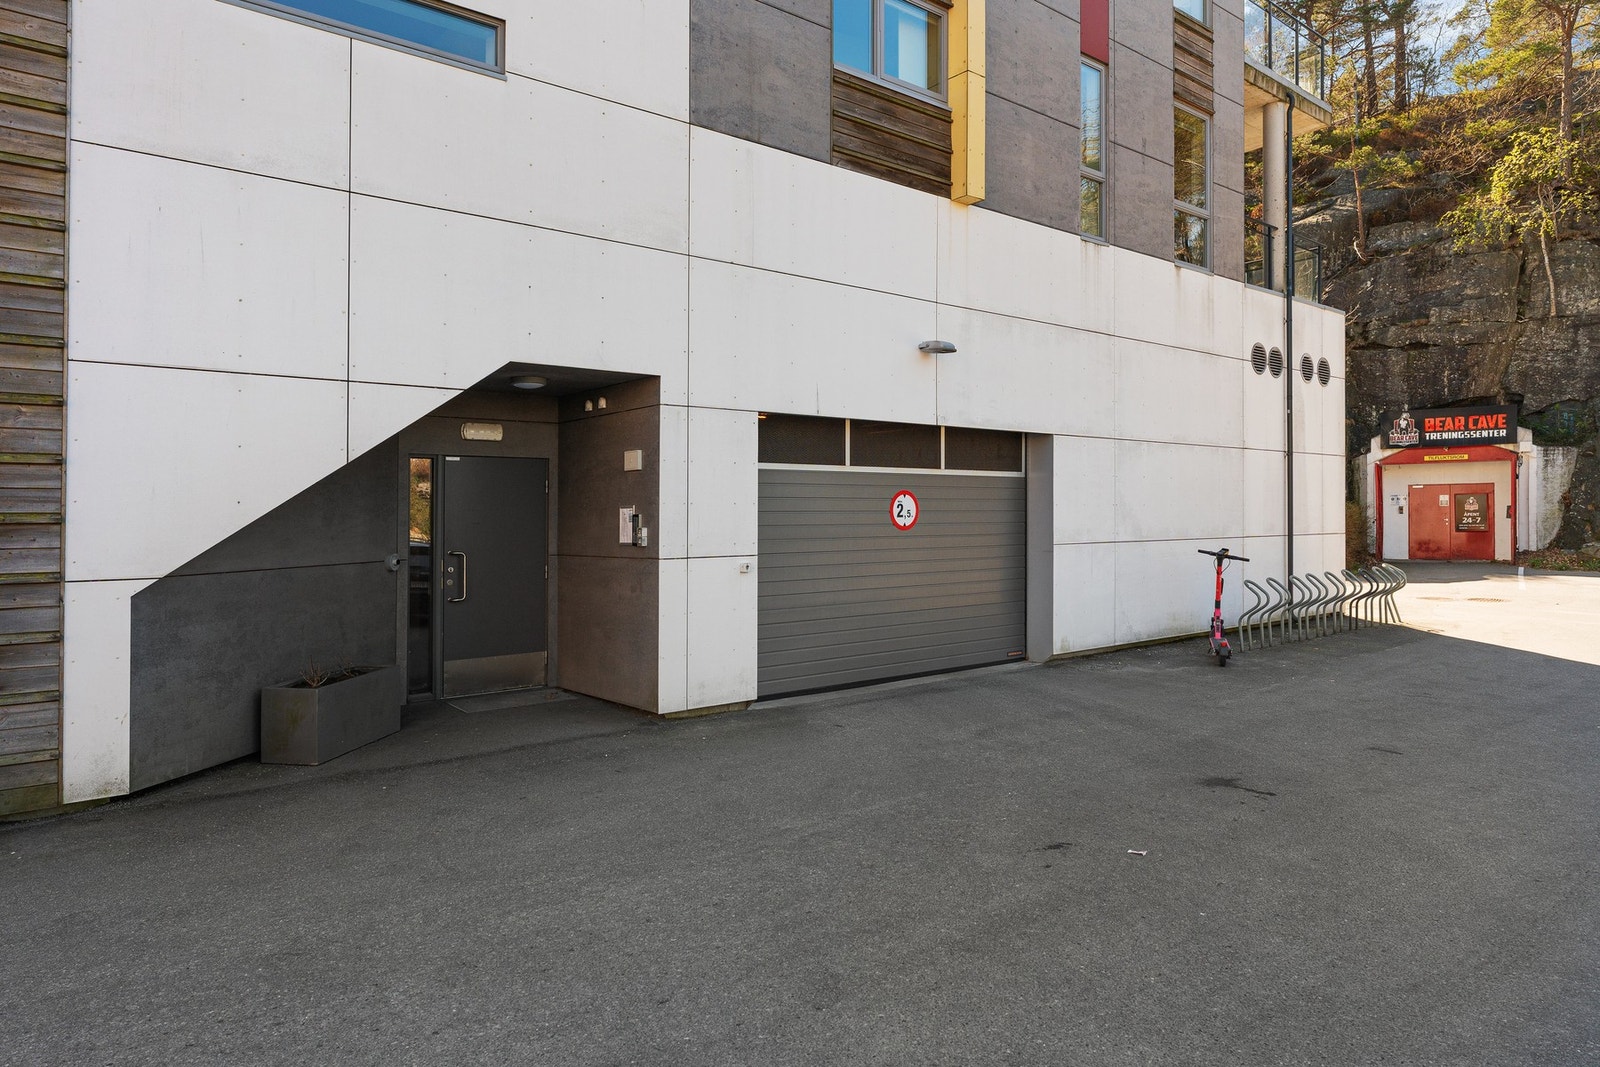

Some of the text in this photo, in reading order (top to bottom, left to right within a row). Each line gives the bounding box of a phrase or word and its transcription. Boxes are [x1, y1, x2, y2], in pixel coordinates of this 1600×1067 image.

[1424, 414, 1507, 431] BEAR CAVE
[1425, 429, 1507, 440] TRENINGSSENTER
[1462, 516, 1481, 524] 24-7
